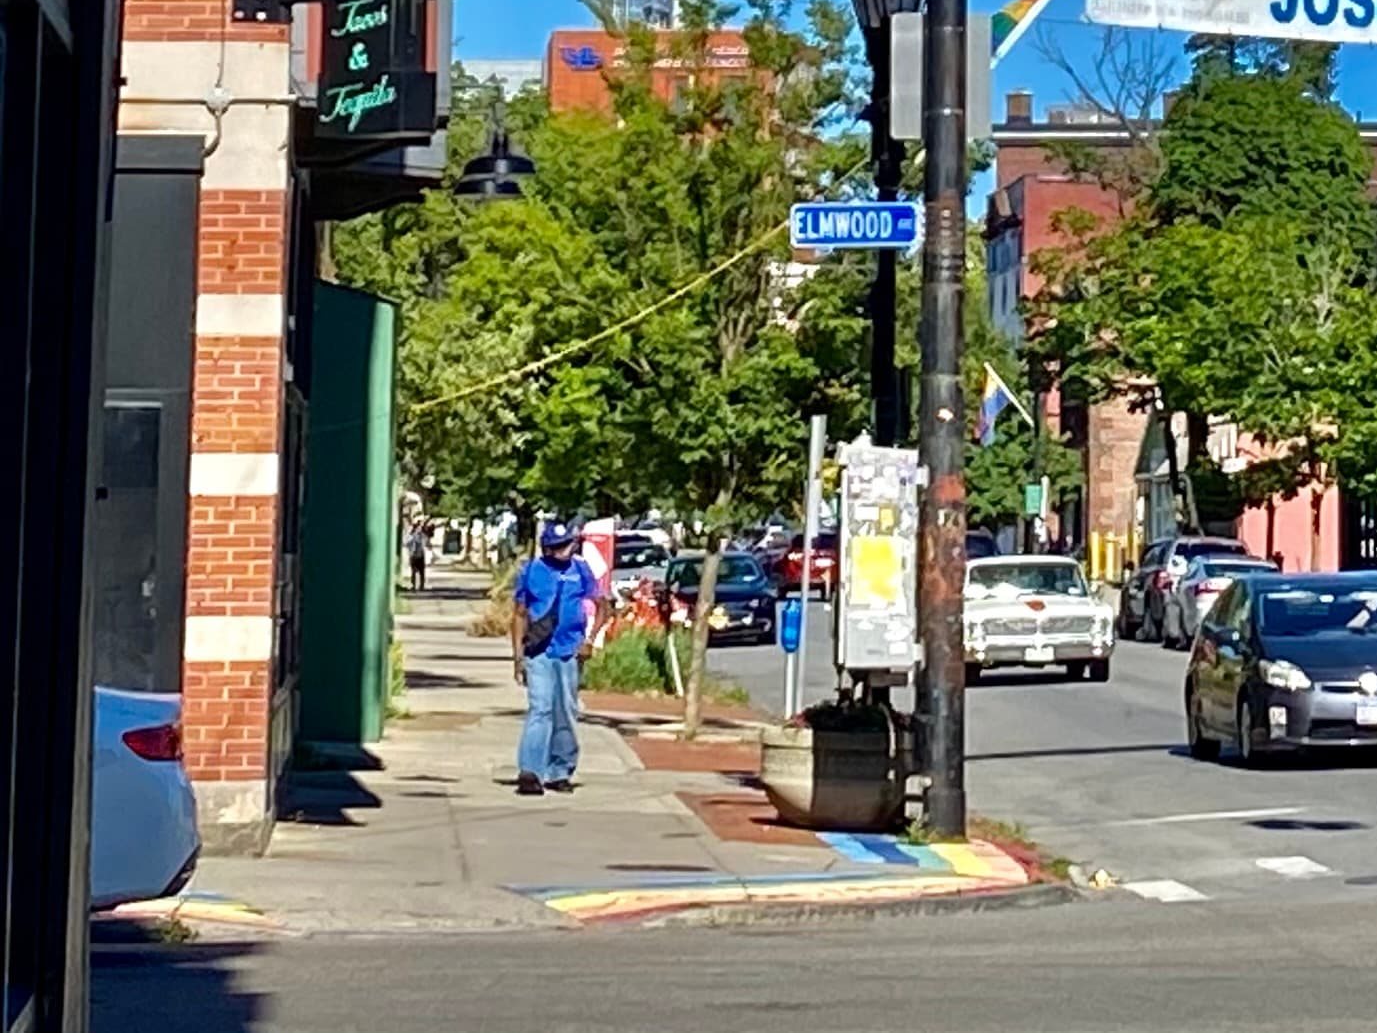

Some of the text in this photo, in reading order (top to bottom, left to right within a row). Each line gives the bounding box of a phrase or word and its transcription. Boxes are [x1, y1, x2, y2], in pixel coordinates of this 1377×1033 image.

[348, 42, 369, 70] &
[319, 74, 398, 133] Tequila
[795, 210, 893, 240] ELMWOOD
